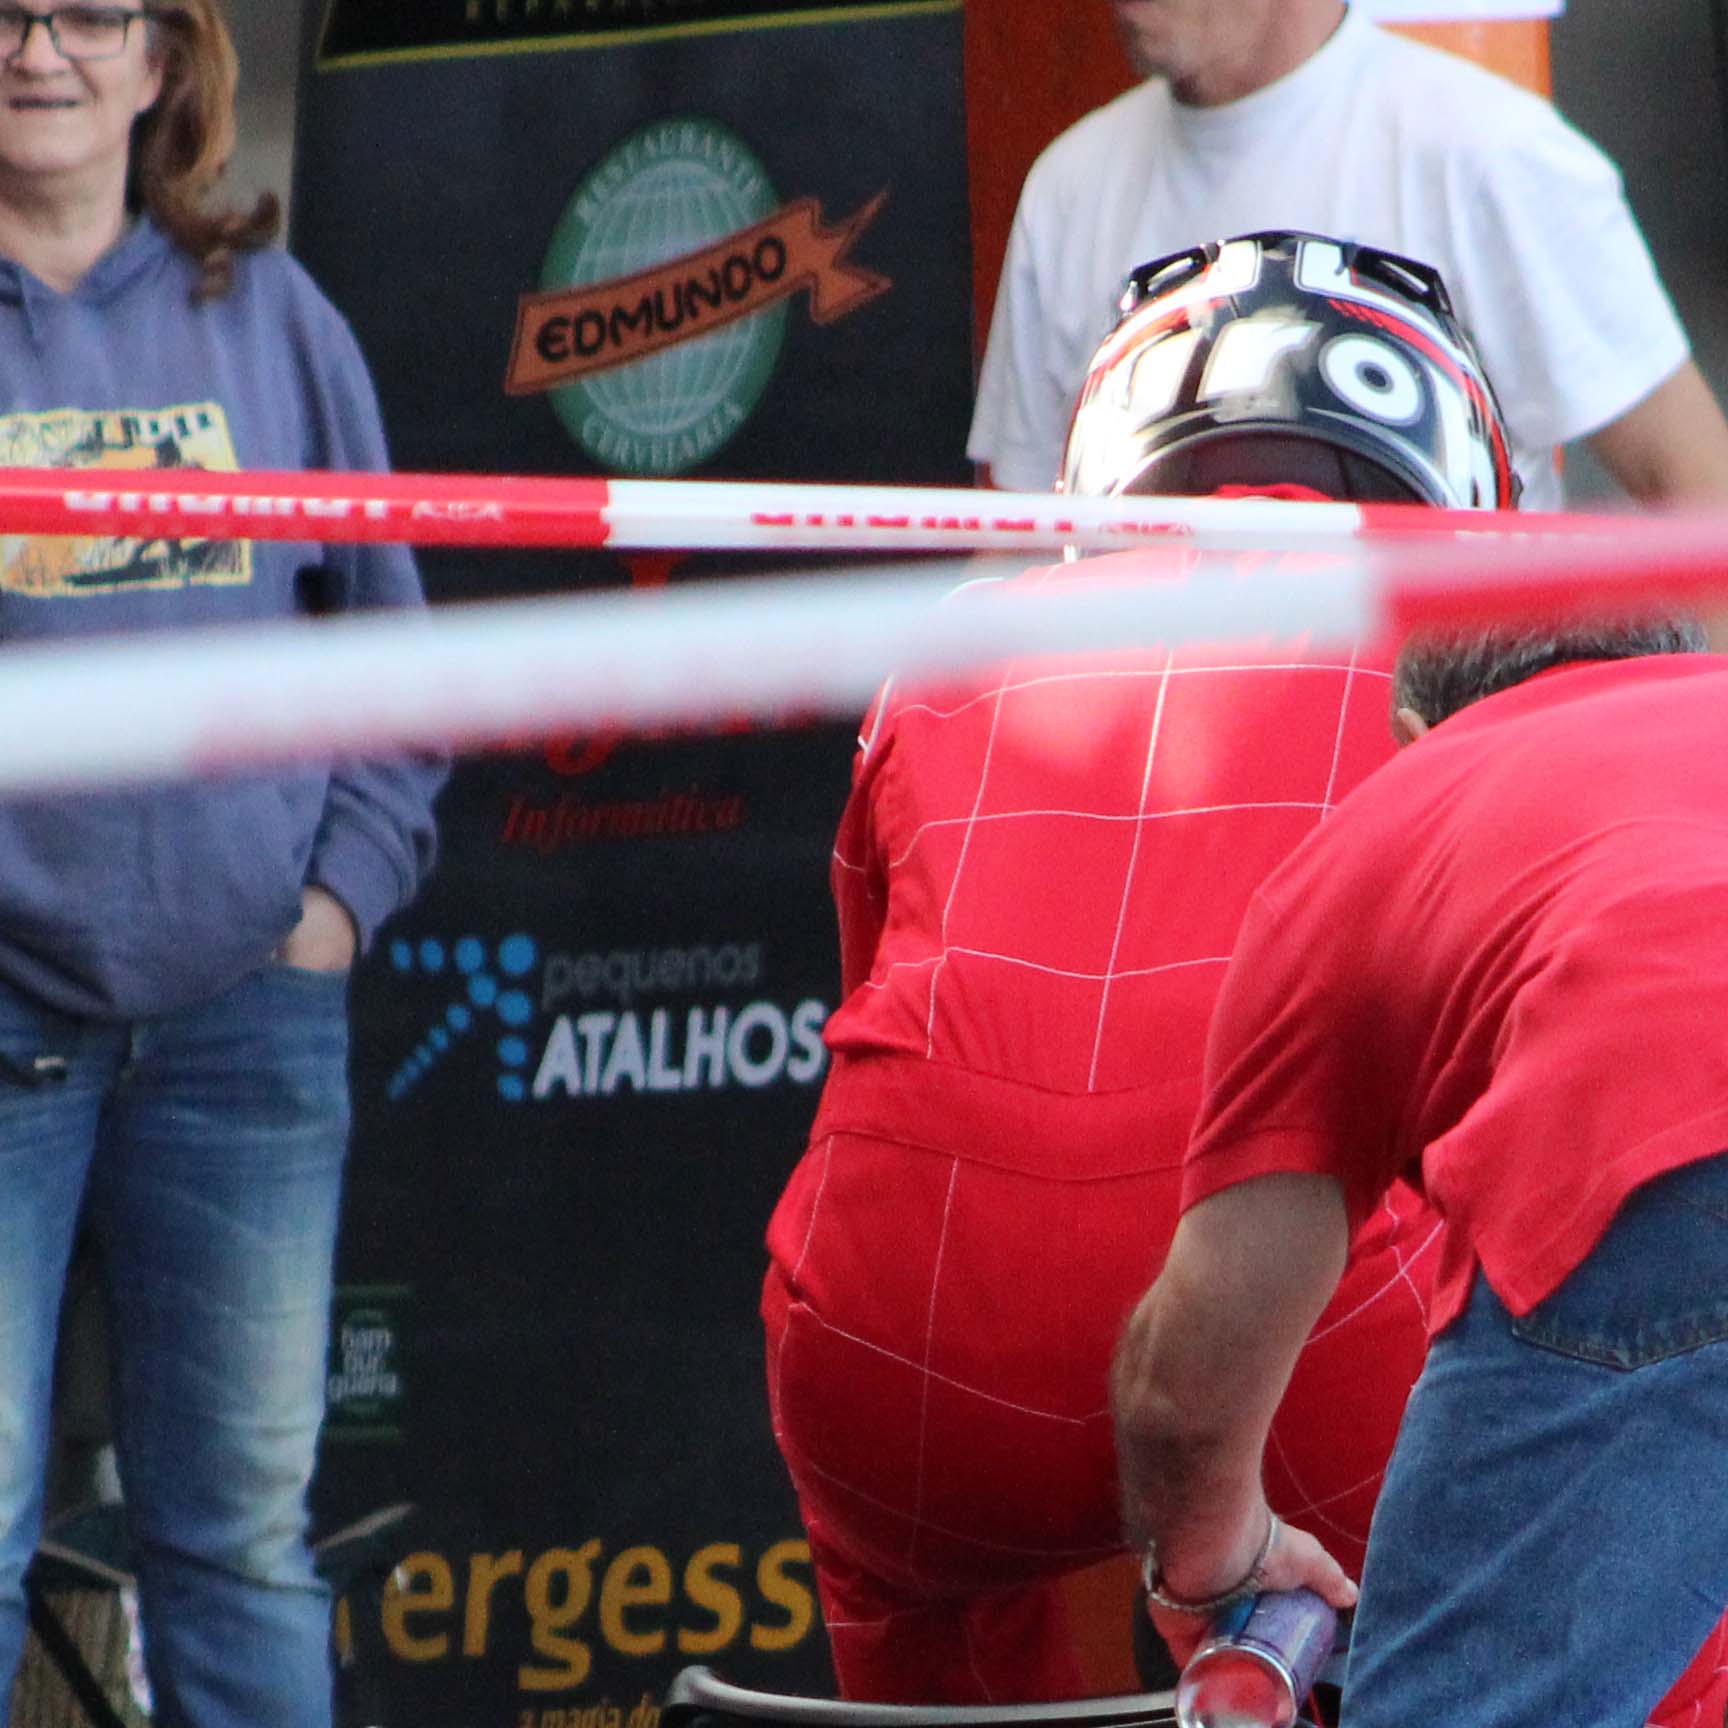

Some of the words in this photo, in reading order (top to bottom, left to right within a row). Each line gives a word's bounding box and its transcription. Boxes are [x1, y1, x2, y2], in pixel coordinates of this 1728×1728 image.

[535, 236, 788, 364] EDMUNDO
[540, 944, 760, 1012] pequenos
[532, 1000, 830, 1098] ATALHOS
[336, 1538, 814, 1691] ergess
